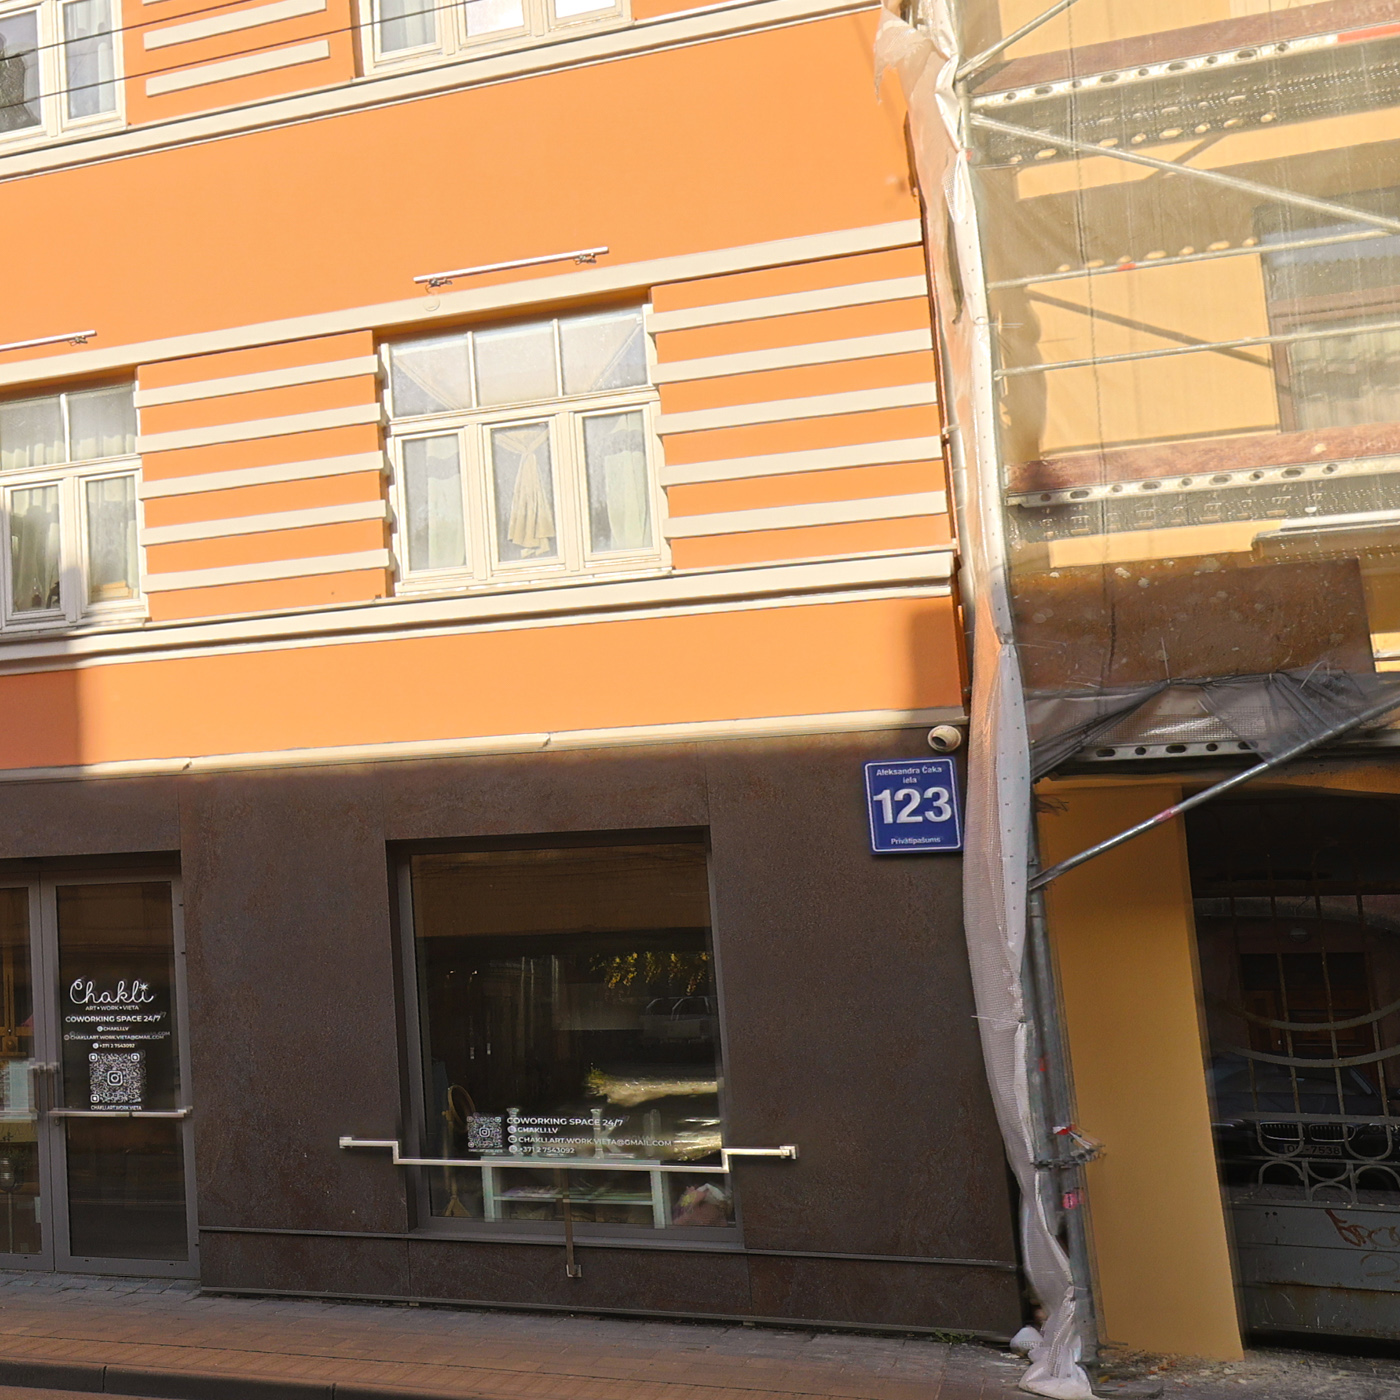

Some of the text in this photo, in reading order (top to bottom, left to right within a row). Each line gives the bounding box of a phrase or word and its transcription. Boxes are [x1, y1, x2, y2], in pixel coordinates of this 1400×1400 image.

[876, 765, 943, 776] Aleksandra Čaka
[903, 776, 917, 784] iela
[873, 787, 952, 824] 123
[69, 978, 154, 1005] Chakli
[65, 1015, 161, 1023] COWORKING SPACE 24/7
[506, 1117, 624, 1127] COWORKING SPACE 24/7
